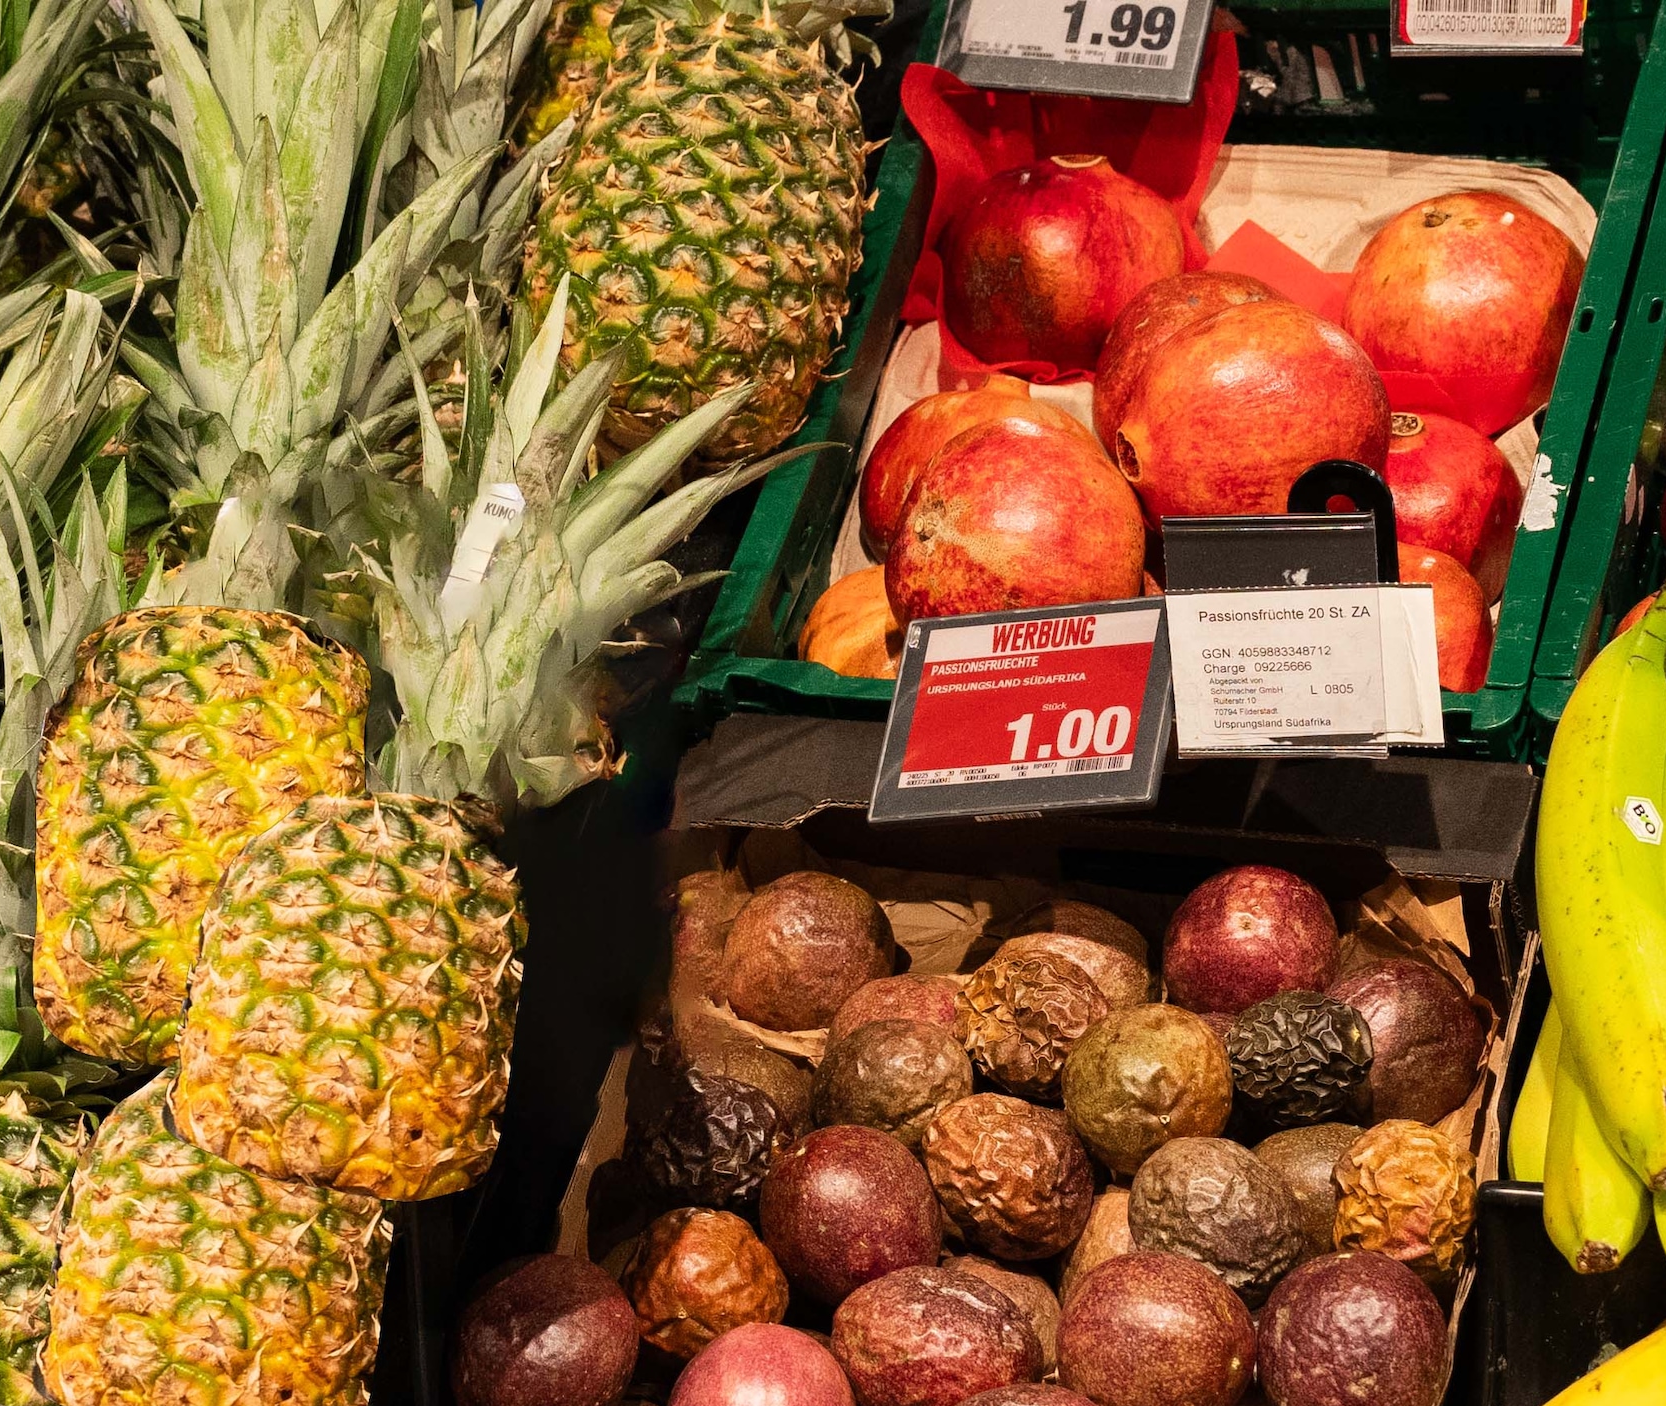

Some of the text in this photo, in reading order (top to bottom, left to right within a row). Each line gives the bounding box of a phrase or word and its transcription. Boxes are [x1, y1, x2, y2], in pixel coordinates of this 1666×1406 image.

[1064, 0, 1175, 50] 1.99
[1199, 608, 1304, 622] Passionsfrüchte
[1308, 608, 1325, 619] 20
[1351, 606, 1371, 617] ZA
[992, 616, 1096, 653] WERBUNG
[1238, 645, 1331, 658] 4059883348712
[931, 656, 1039, 677] PASSIONSFRUECHTE
[1204, 661, 1312, 675] Charge 09225666
[927, 672, 1086, 695] URSPRUNGSLAND SÜDAFRIKA
[1209, 677, 1249, 685] Abgepackt
[1210, 686, 1283, 695] Schumacher GmbH
[1310, 685, 1317, 694] L
[1042, 701, 1068, 711] Stück
[1239, 707, 1278, 715] Filderstadt
[1214, 718, 1331, 730] Ursprungsland Südafrika
[1006, 706, 1131, 761] 1.00
